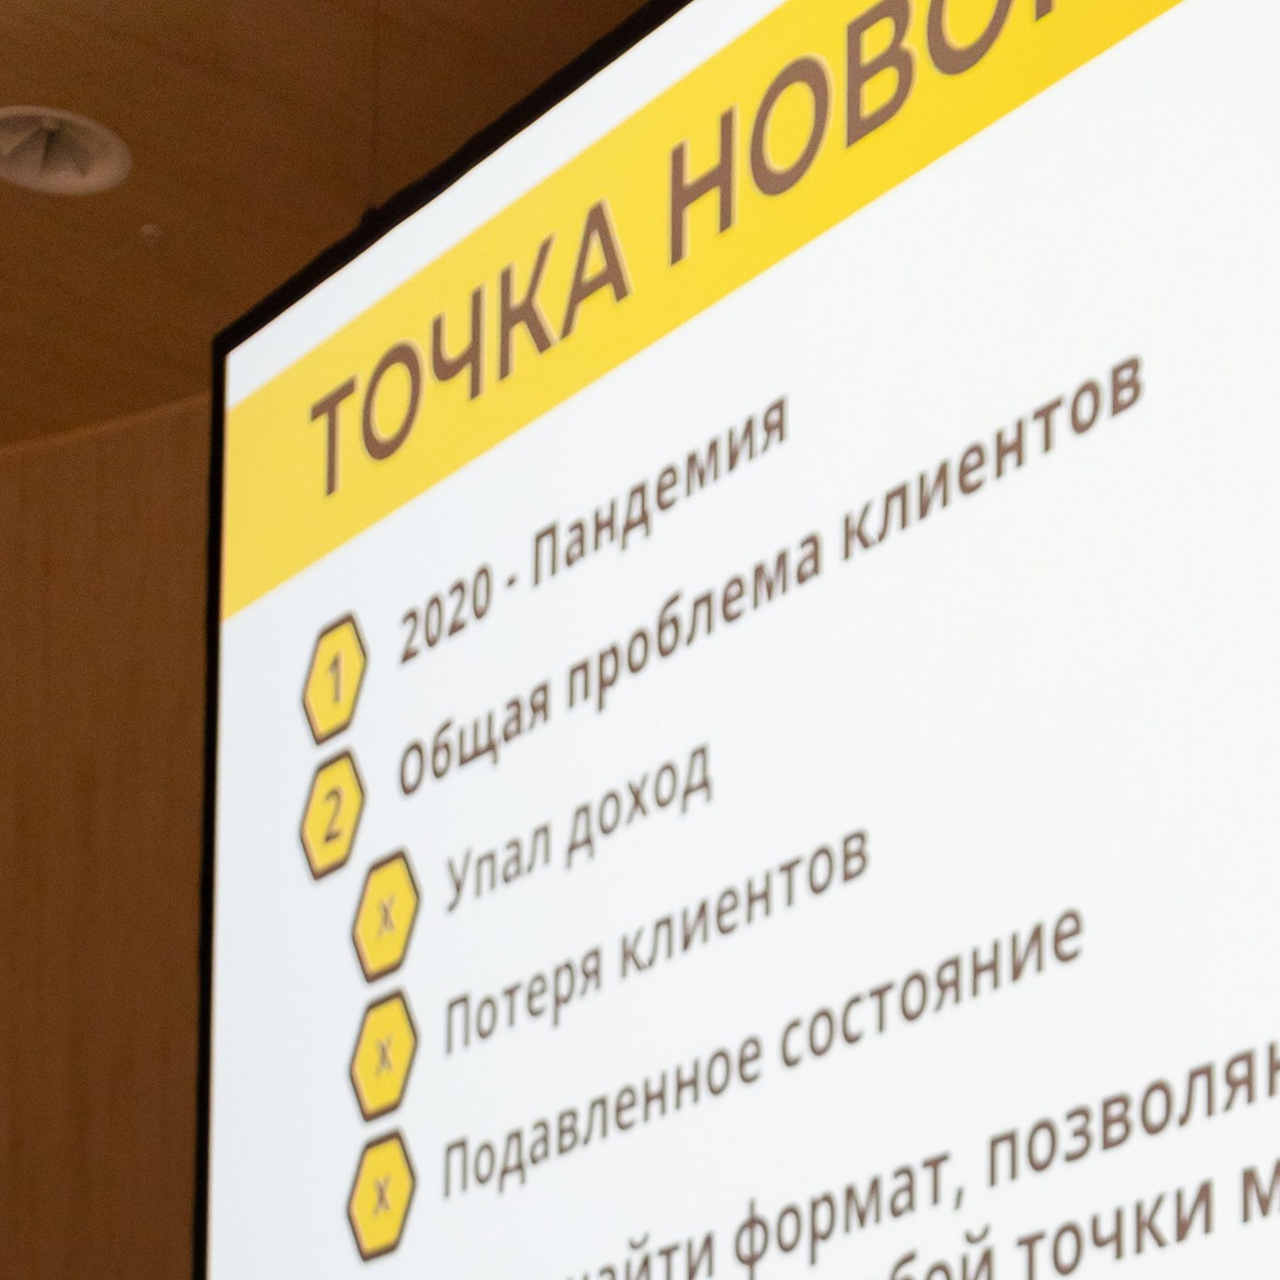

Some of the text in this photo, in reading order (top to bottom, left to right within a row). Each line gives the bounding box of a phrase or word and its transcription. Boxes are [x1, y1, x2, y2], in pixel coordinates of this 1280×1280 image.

[311, 0, 1053, 496] ТОЧКА НОВО
[399, 682, 549, 796] Общая
[569, 534, 821, 712] проблема
[844, 357, 1141, 560] клиентов
[401, 566, 491, 664] 2020
[534, 398, 785, 586] Пандемия
[447, 948, 601, 1054] Потеря
[622, 831, 868, 977] клиентов
[448, 825, 549, 912] Упал
[567, 746, 711, 868] доход
[444, 1037, 761, 1197] Подавленное
[781, 910, 1082, 1067] состояние
